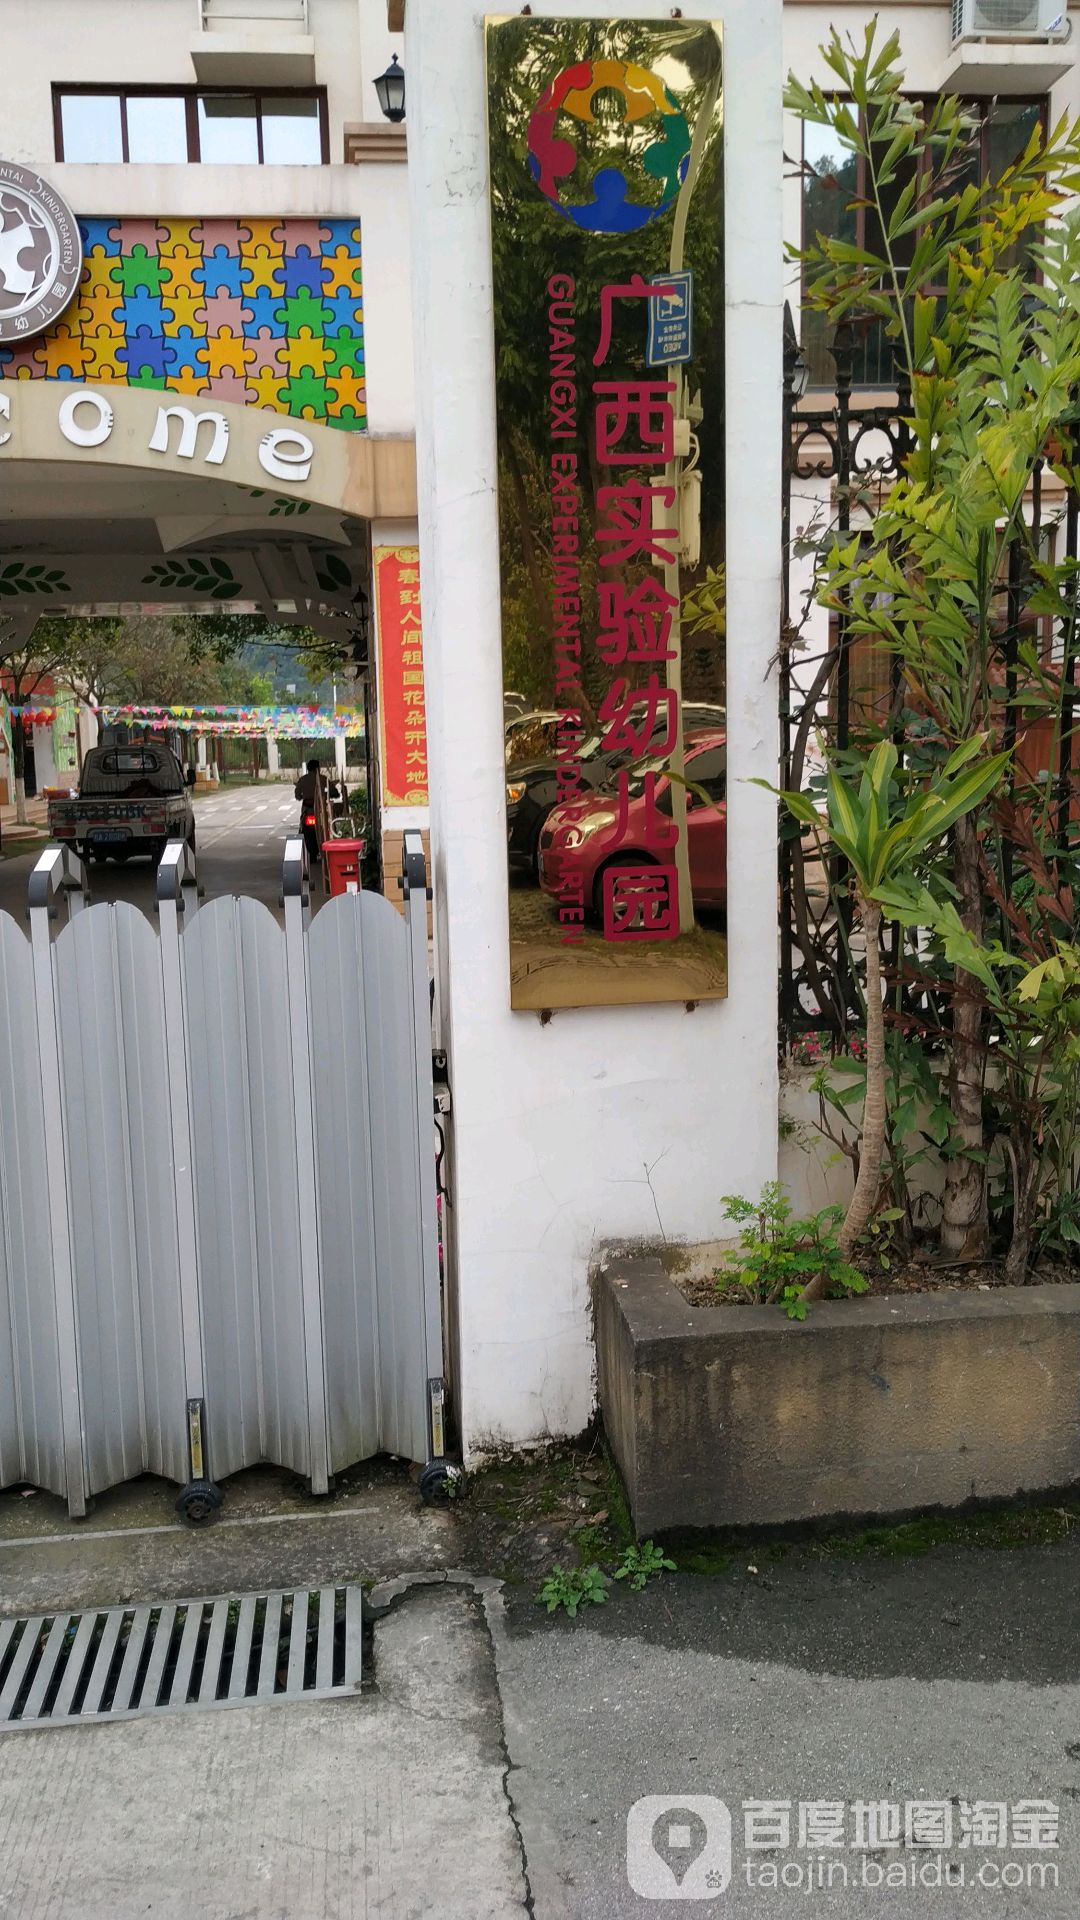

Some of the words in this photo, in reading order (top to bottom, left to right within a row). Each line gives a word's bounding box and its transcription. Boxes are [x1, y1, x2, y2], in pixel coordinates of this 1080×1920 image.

[0, 282, 68, 335] 幼儿园
[40, 190, 73, 264] KINDERGARTEN
[0, 390, 314, 481] ome
[547, 273, 577, 438] GUANGXI
[551, 453, 583, 696] EXPERIMENTAL
[592, 273, 680, 942] 广西实验幼儿园
[556, 707, 585, 945] KINDERGARTEN
